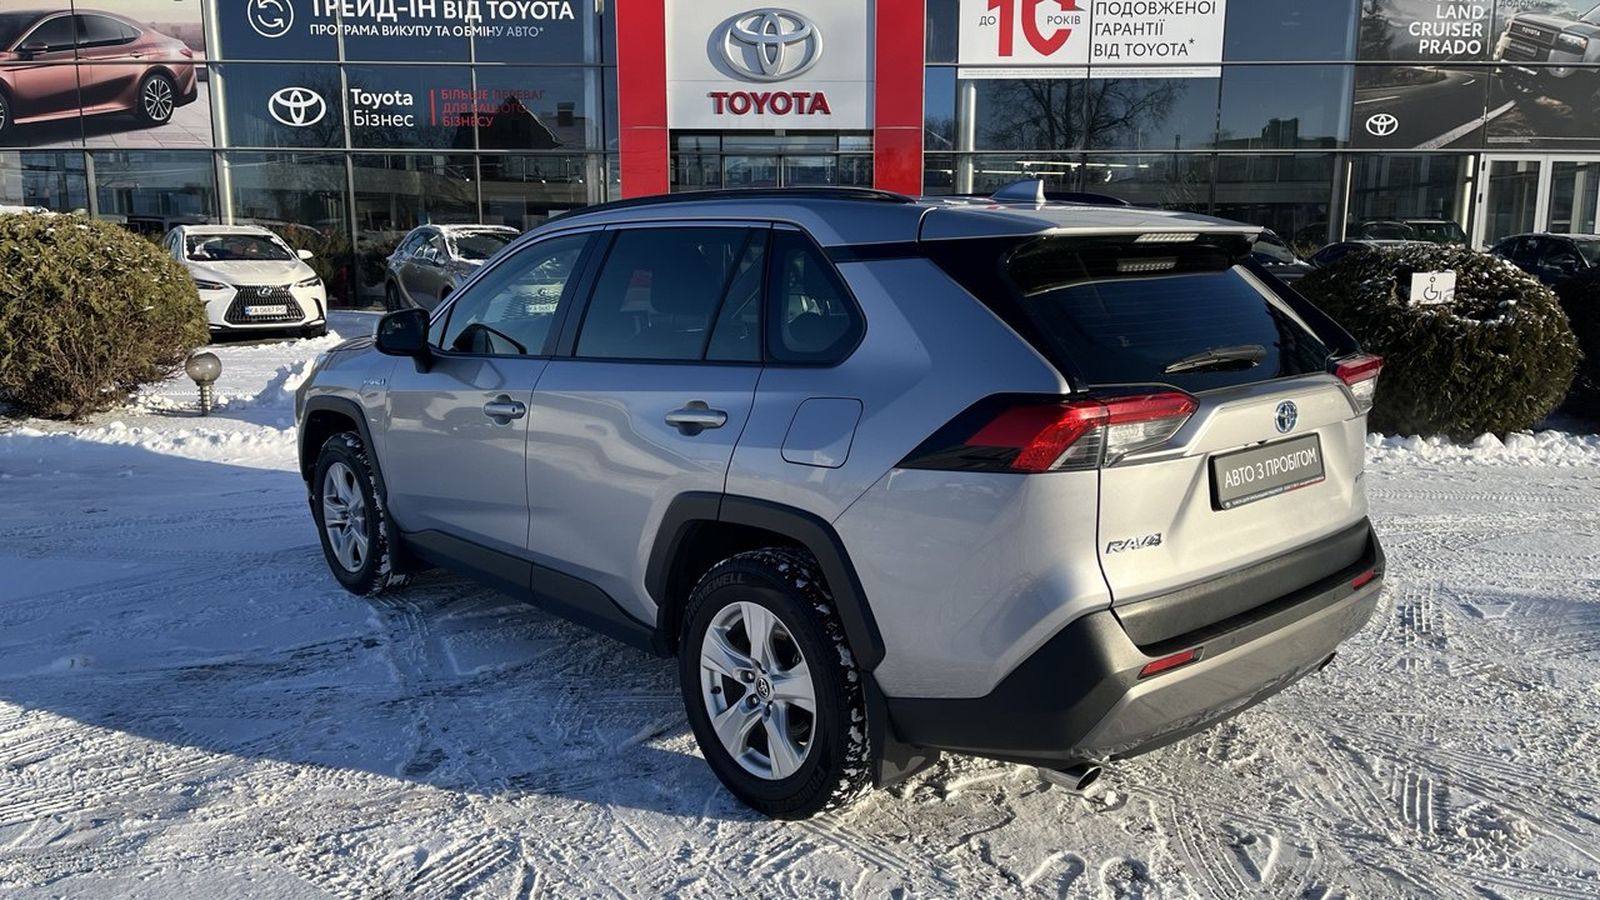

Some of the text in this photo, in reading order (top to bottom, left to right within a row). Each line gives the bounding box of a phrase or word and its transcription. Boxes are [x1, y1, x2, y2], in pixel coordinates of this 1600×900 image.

[444, 1, 482, 23] ВІД
[486, 1, 575, 20] TOYOTA
[978, 15, 997, 26] ДО
[1046, 15, 1081, 25] РОКІВ
[1436, 4, 1484, 20] LAND
[309, 24, 380, 36] ПРОГРАМА
[382, 25, 433, 37] ВИКУПУ
[435, 25, 450, 37] ТА
[453, 25, 503, 37] ОБМІНУ
[1095, 19, 1165, 36] ГАРАНТІЇ
[1408, 21, 1483, 37] CRUISER
[1094, 43, 1120, 59] ВІД
[1418, 39, 1482, 55] PRADO
[350, 88, 413, 109] Toyota
[709, 91, 831, 116] TOYOTA
[353, 109, 415, 127] Бізнес
[1225, 465, 1255, 489] АВТО
[1265, 447, 1318, 477] ПРОБІГОМ
[1105, 532, 1162, 554] RAV4
